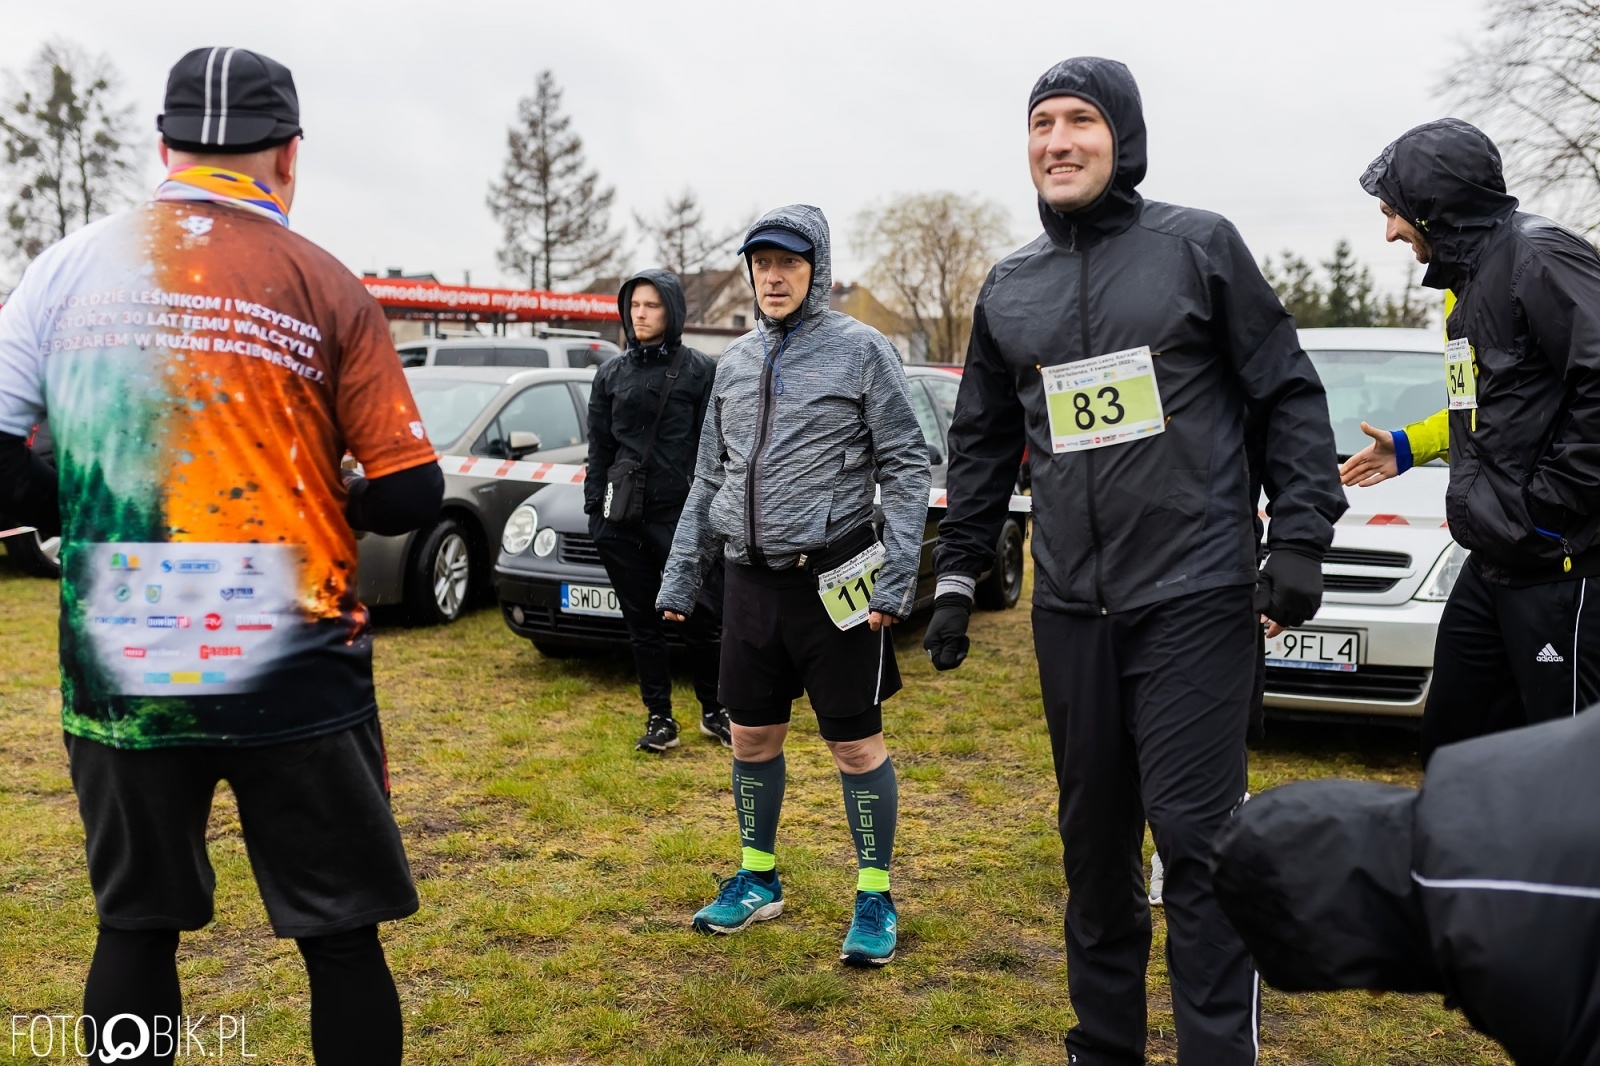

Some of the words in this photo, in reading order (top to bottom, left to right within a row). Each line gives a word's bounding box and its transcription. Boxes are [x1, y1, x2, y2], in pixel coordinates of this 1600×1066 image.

[130, 287, 222, 311] LEŚNIKOM
[224, 298, 233, 312] I
[540, 294, 618, 315] bezdotykow
[122, 310, 144, 325] 30
[146, 311, 180, 327] LAT
[180, 313, 231, 332] TEMU
[233, 319, 315, 359] WALCZYLI
[133, 333, 153, 348] W
[155, 331, 211, 353] KUŹNI
[1449, 363, 1465, 394] 54
[1073, 386, 1125, 430] 83
[603, 482, 613, 518] adidas
[570, 588, 601, 609] SWD
[607, 590, 621, 611] 0
[1283, 634, 1353, 662] 9FL4
[1536, 654, 1564, 662] adidas
